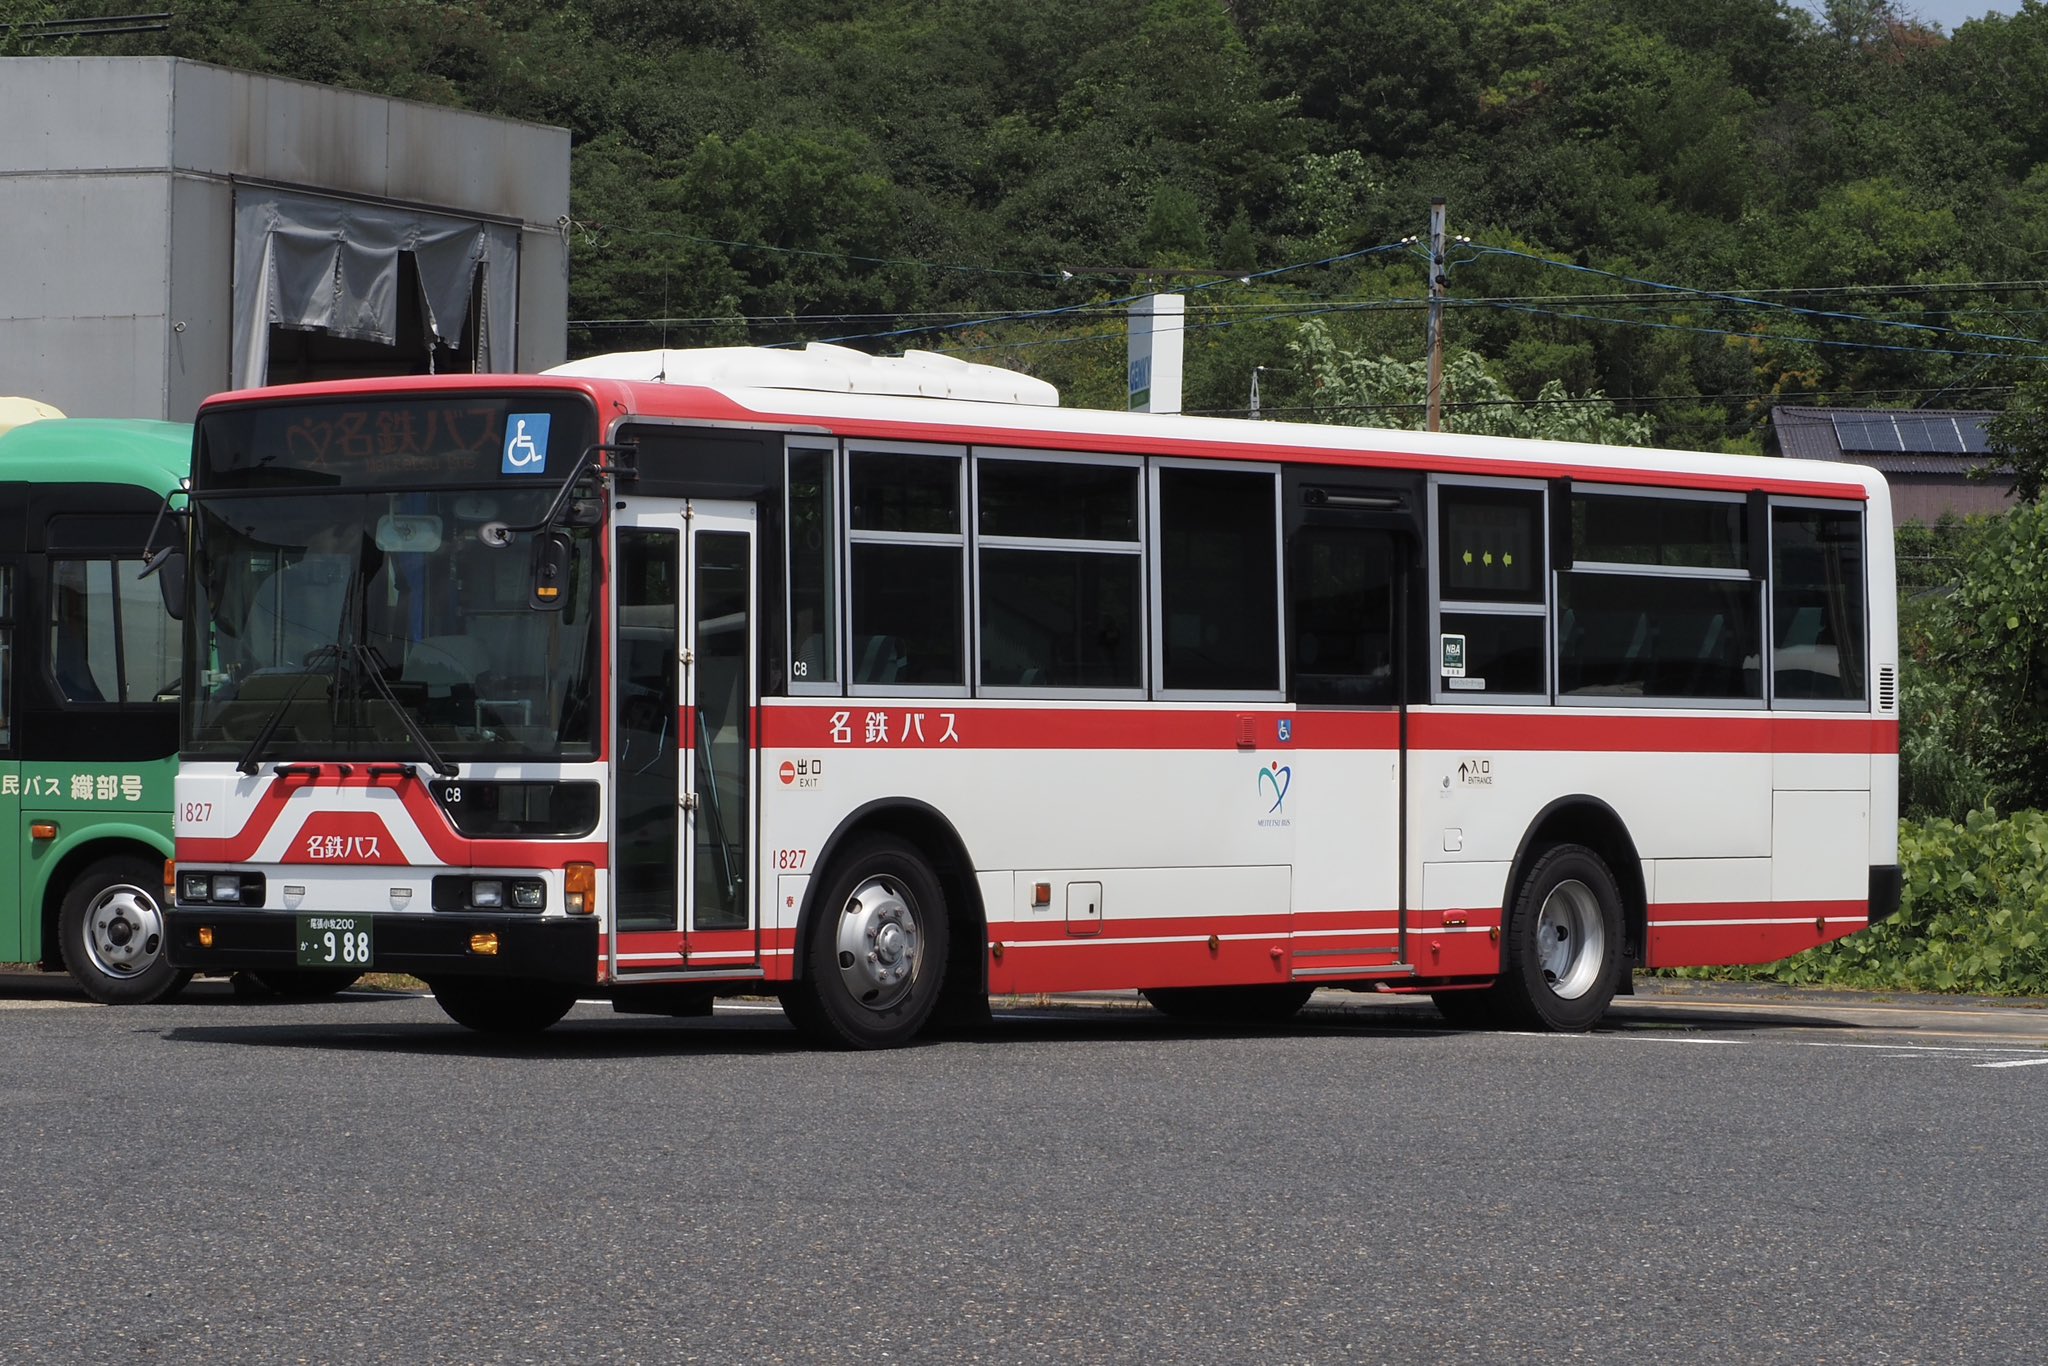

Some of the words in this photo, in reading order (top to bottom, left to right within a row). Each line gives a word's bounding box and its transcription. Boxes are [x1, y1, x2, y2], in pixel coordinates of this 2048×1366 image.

[336, 407, 502, 456] 名鉄バス
[793, 661, 808, 676] C8
[829, 711, 959, 744] 名鉄バス
[797, 758, 822, 775] 出口
[1471, 760, 1490, 774] 入口
[70, 774, 143, 801] 織部号
[799, 778, 818, 788] EXIT
[1468, 776, 1492, 785] ENTRANCE
[444, 787, 462, 803] C8
[179, 803, 213, 822] 1827
[306, 835, 381, 859] 名鉄バス
[773, 850, 807, 869] 1827
